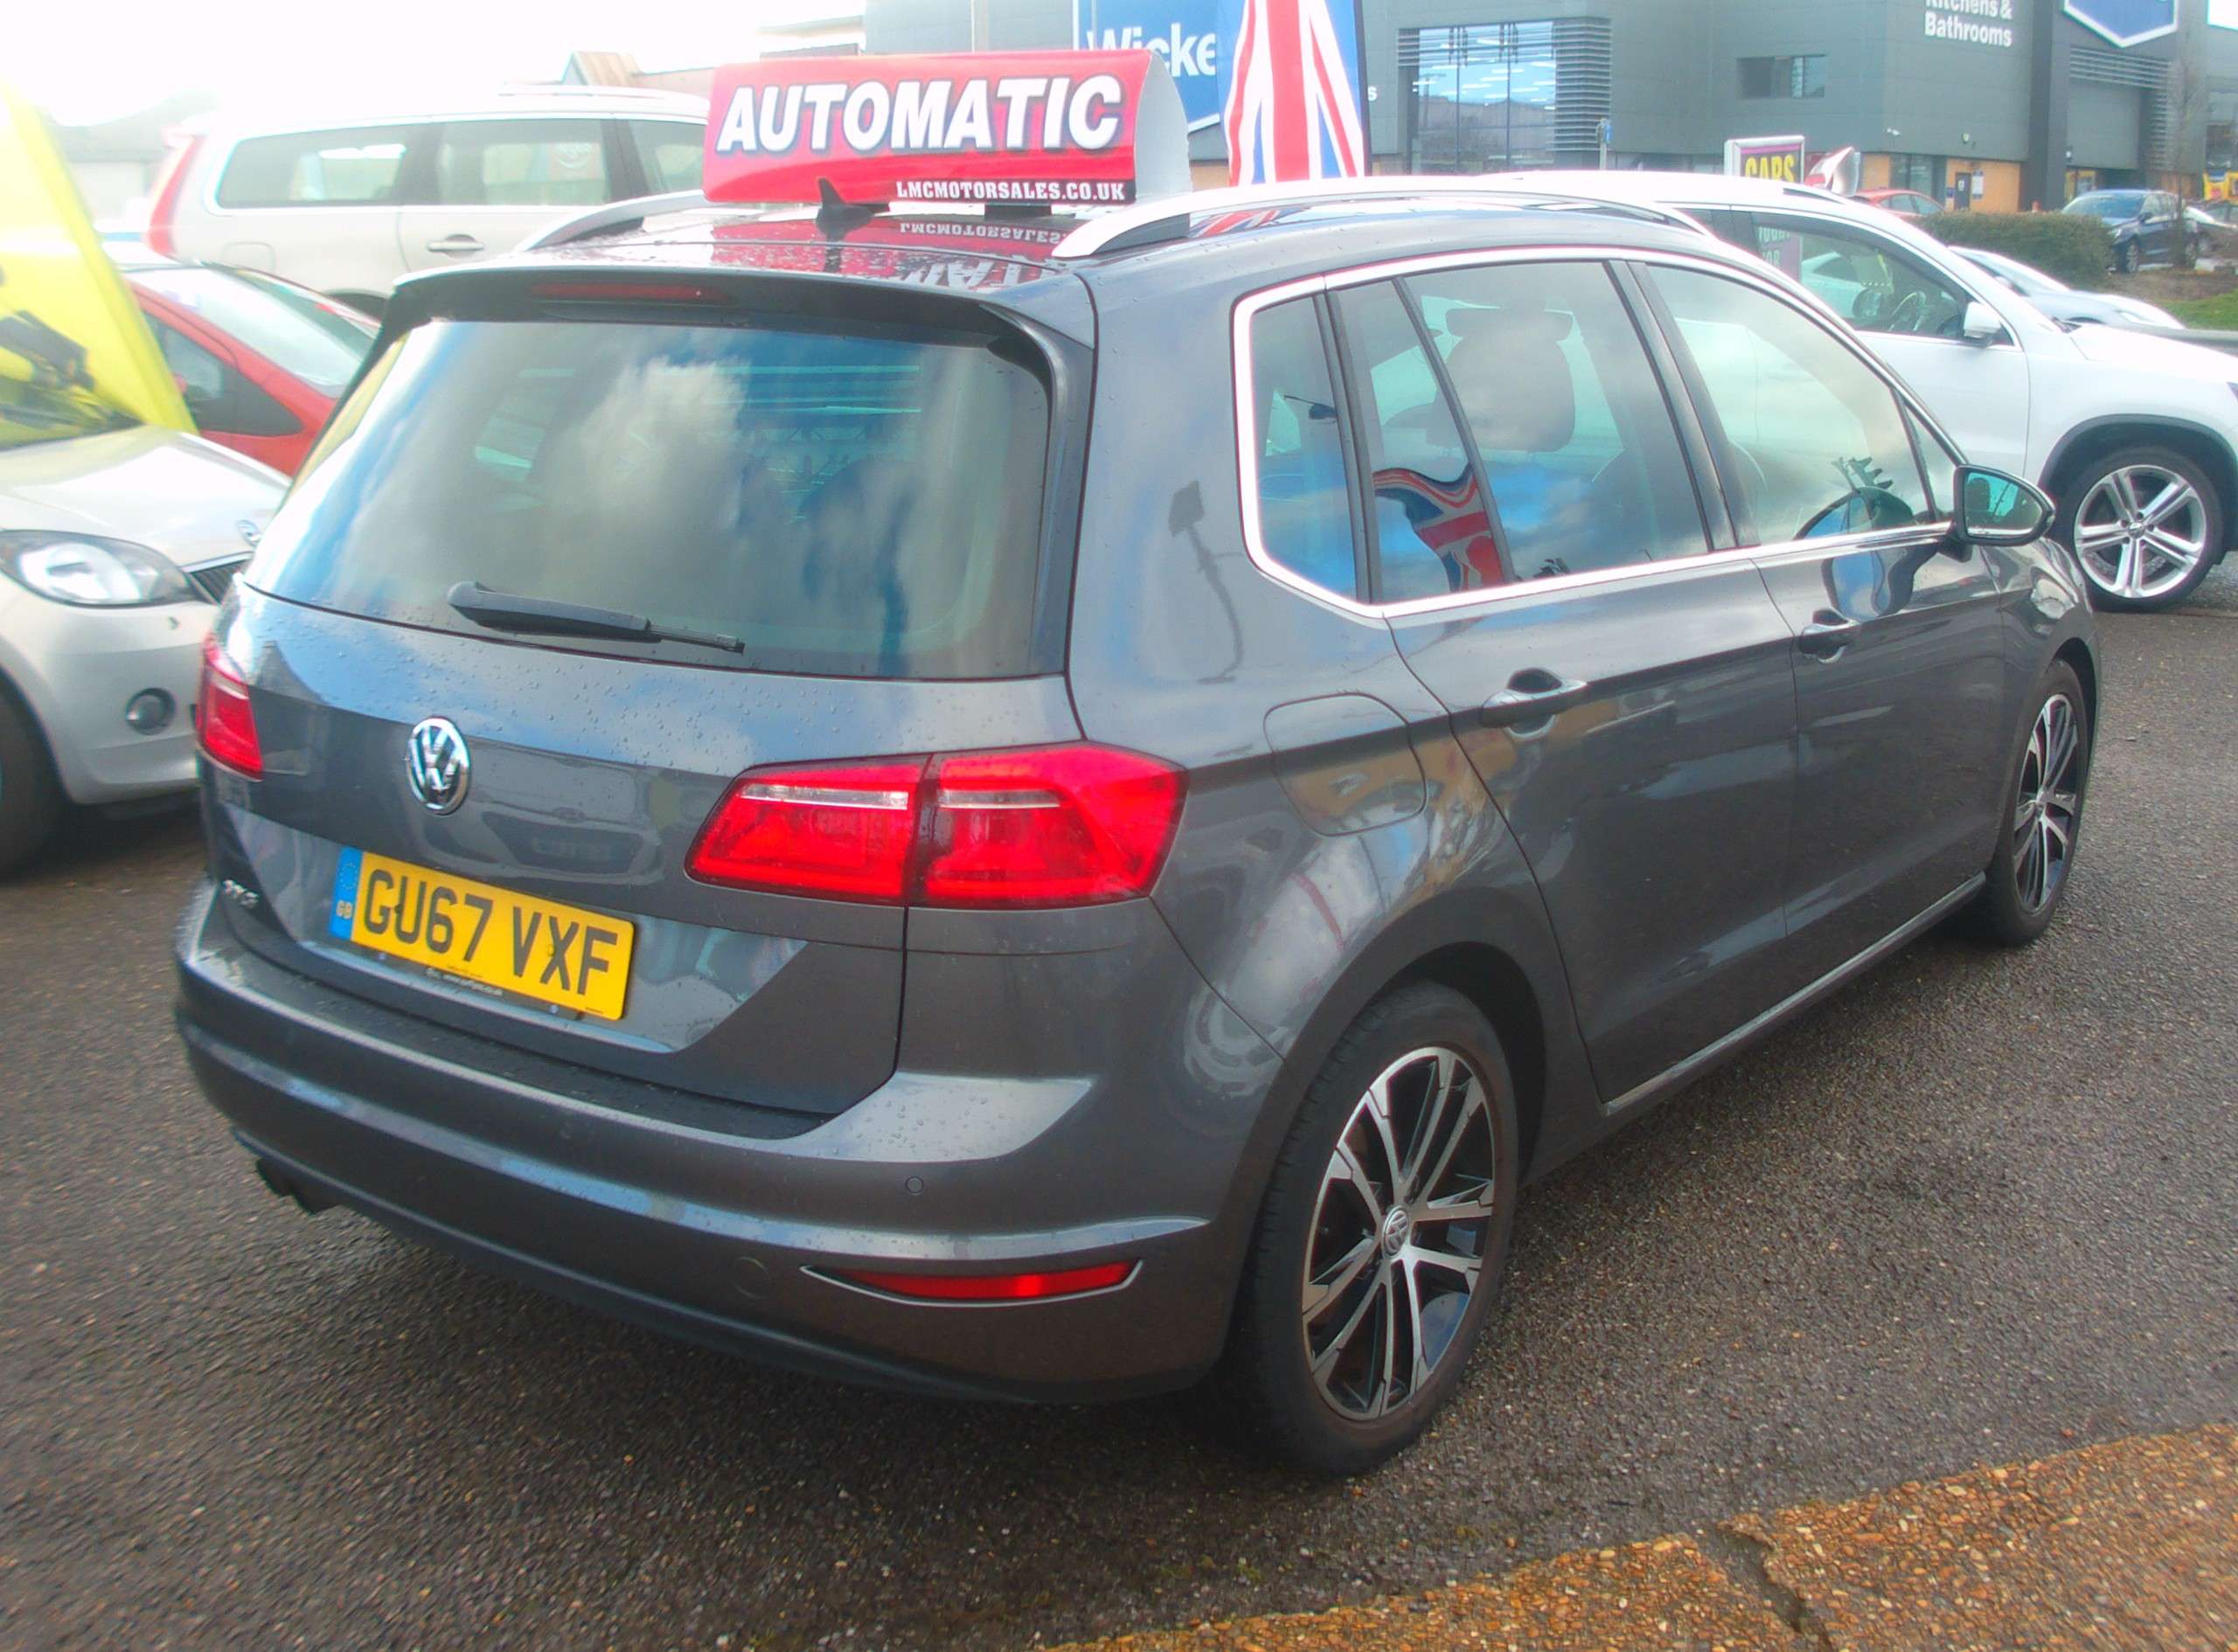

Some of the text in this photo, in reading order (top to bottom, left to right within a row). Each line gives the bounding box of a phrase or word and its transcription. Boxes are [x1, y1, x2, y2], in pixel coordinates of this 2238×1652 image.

[1924, 10, 2013, 47] Bathrooms
[716, 75, 1122, 152] AUTOMATIC
[1745, 154, 1795, 183] CARS
[895, 180, 1126, 201] LMCMOTORSALES.CO.UK
[364, 868, 618, 996] GU67 VXF
